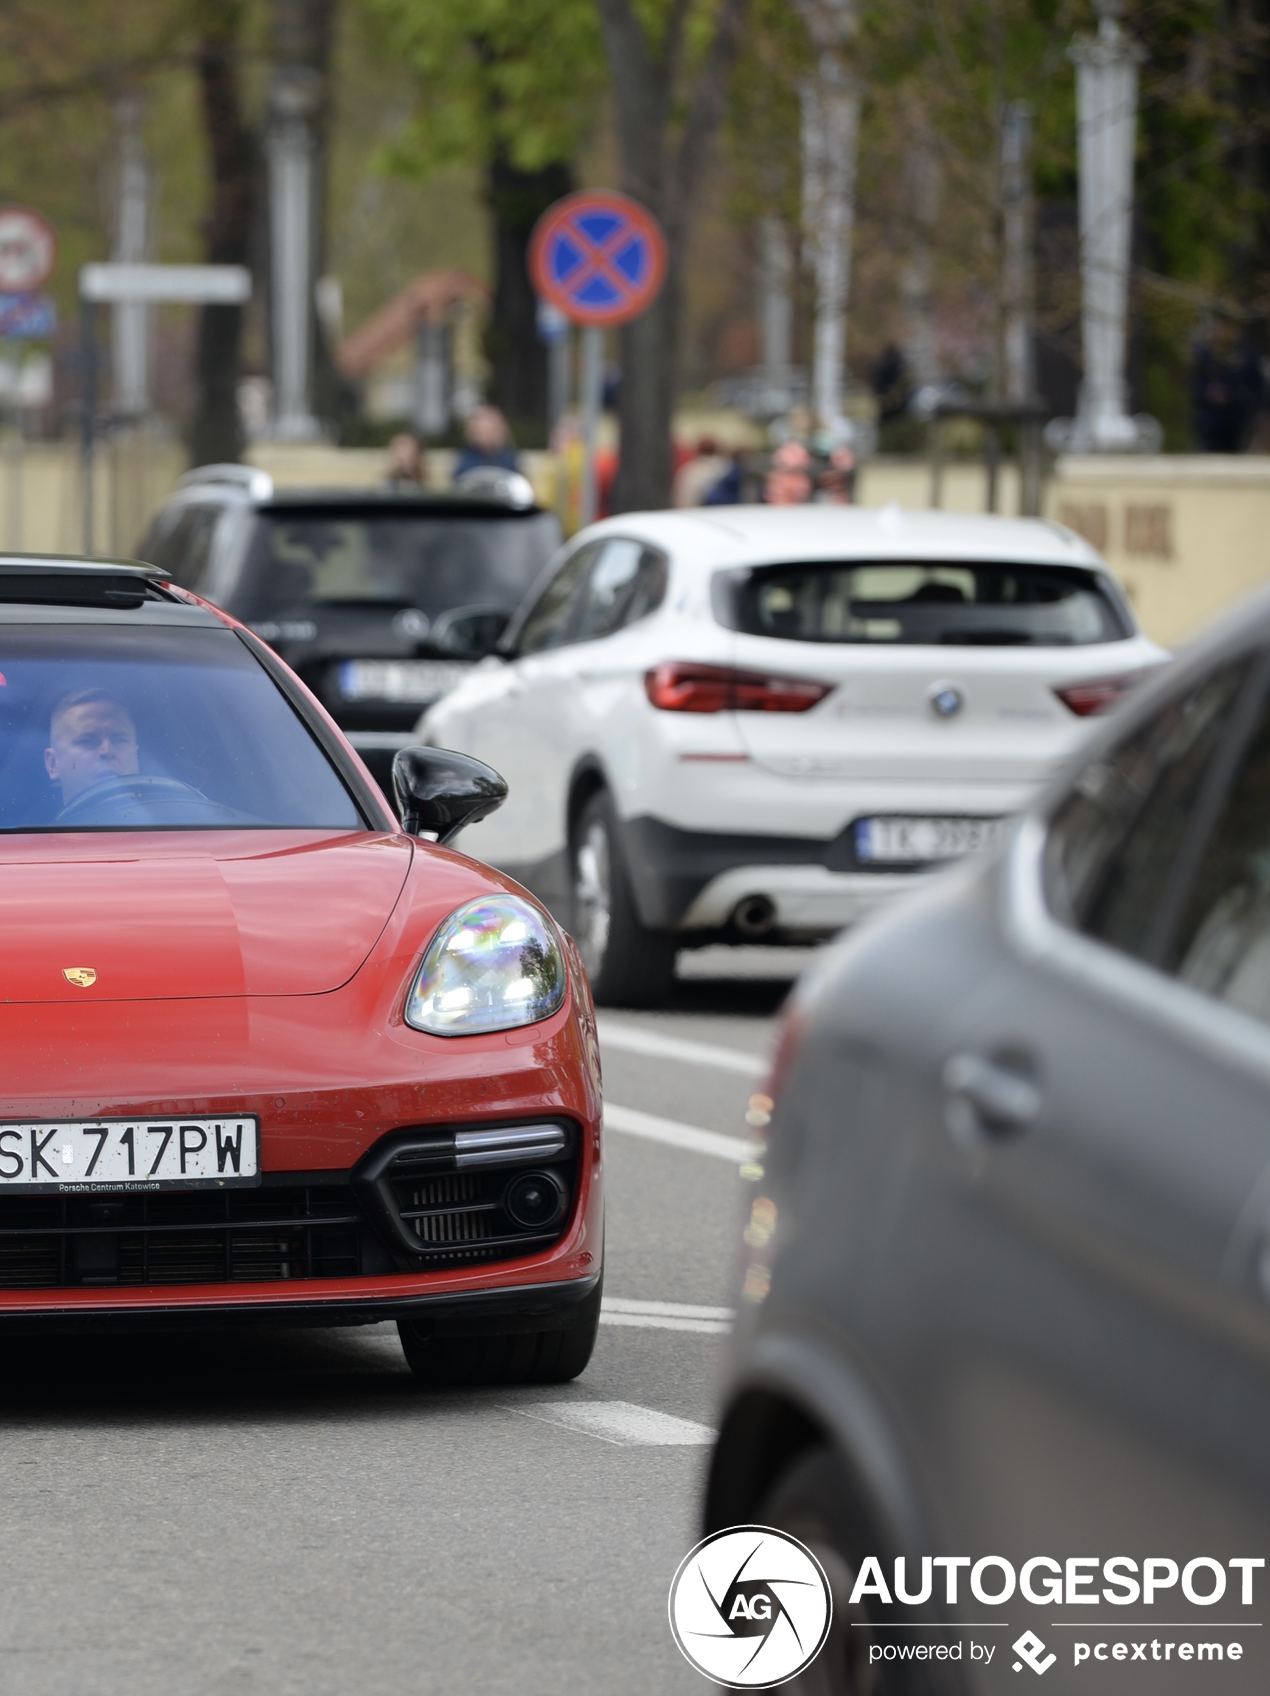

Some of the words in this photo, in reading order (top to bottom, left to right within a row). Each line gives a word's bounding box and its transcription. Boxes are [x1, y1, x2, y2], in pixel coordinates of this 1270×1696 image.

[82, 1124, 244, 1177] 717PW
[59, 1183, 90, 1192] Porsche
[91, 1182, 124, 1191] Centrum
[125, 1181, 160, 1190] Katowice
